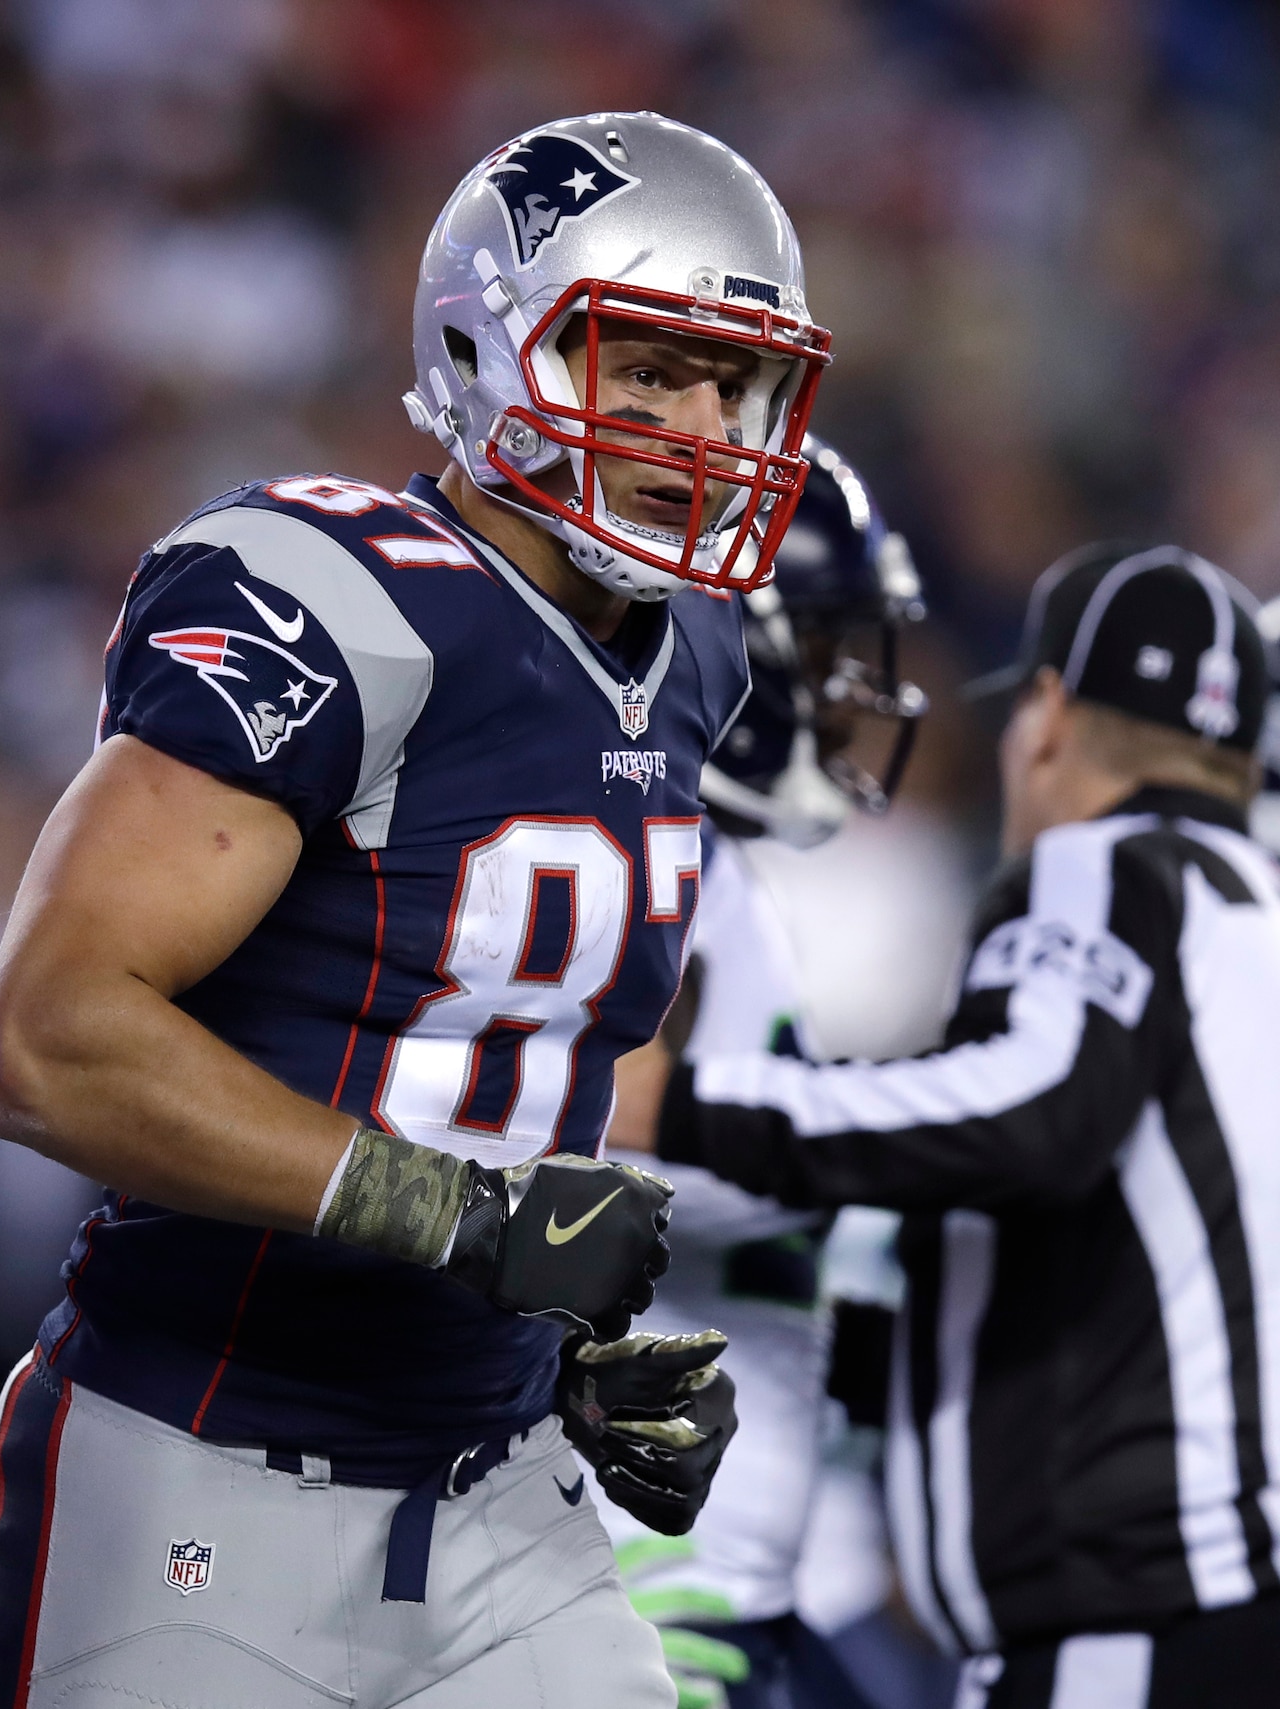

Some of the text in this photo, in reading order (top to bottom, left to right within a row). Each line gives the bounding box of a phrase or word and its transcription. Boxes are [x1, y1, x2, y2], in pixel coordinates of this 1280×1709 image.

[723, 275, 780, 310] PATRIOTS
[263, 474, 498, 583] 87
[624, 705, 645, 729] NFL
[601, 750, 668, 783] PATRIOTS
[170, 1560, 204, 1586] NFL
